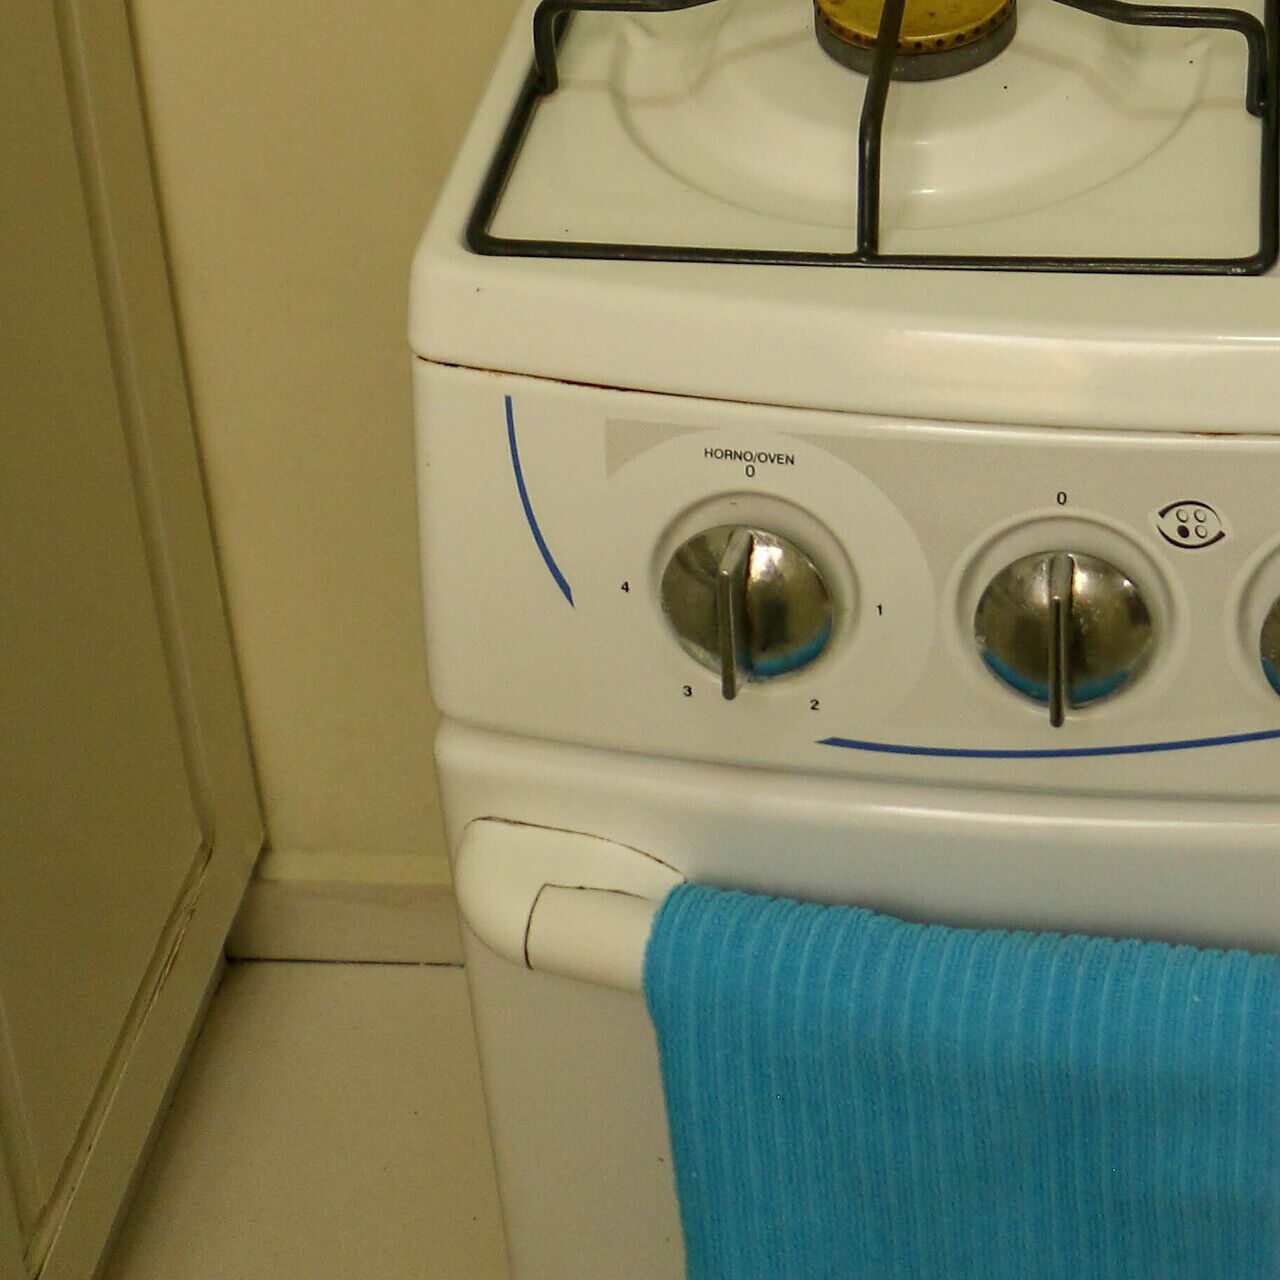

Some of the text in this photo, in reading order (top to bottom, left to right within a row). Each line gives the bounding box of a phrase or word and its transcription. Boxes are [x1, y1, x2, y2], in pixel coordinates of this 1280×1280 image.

[704, 447, 795, 465] HORNO/OVEN
[620, 580, 630, 593] 4
[876, 604, 883, 616] 1
[683, 685, 693, 698] 3
[810, 698, 820, 711] 2
